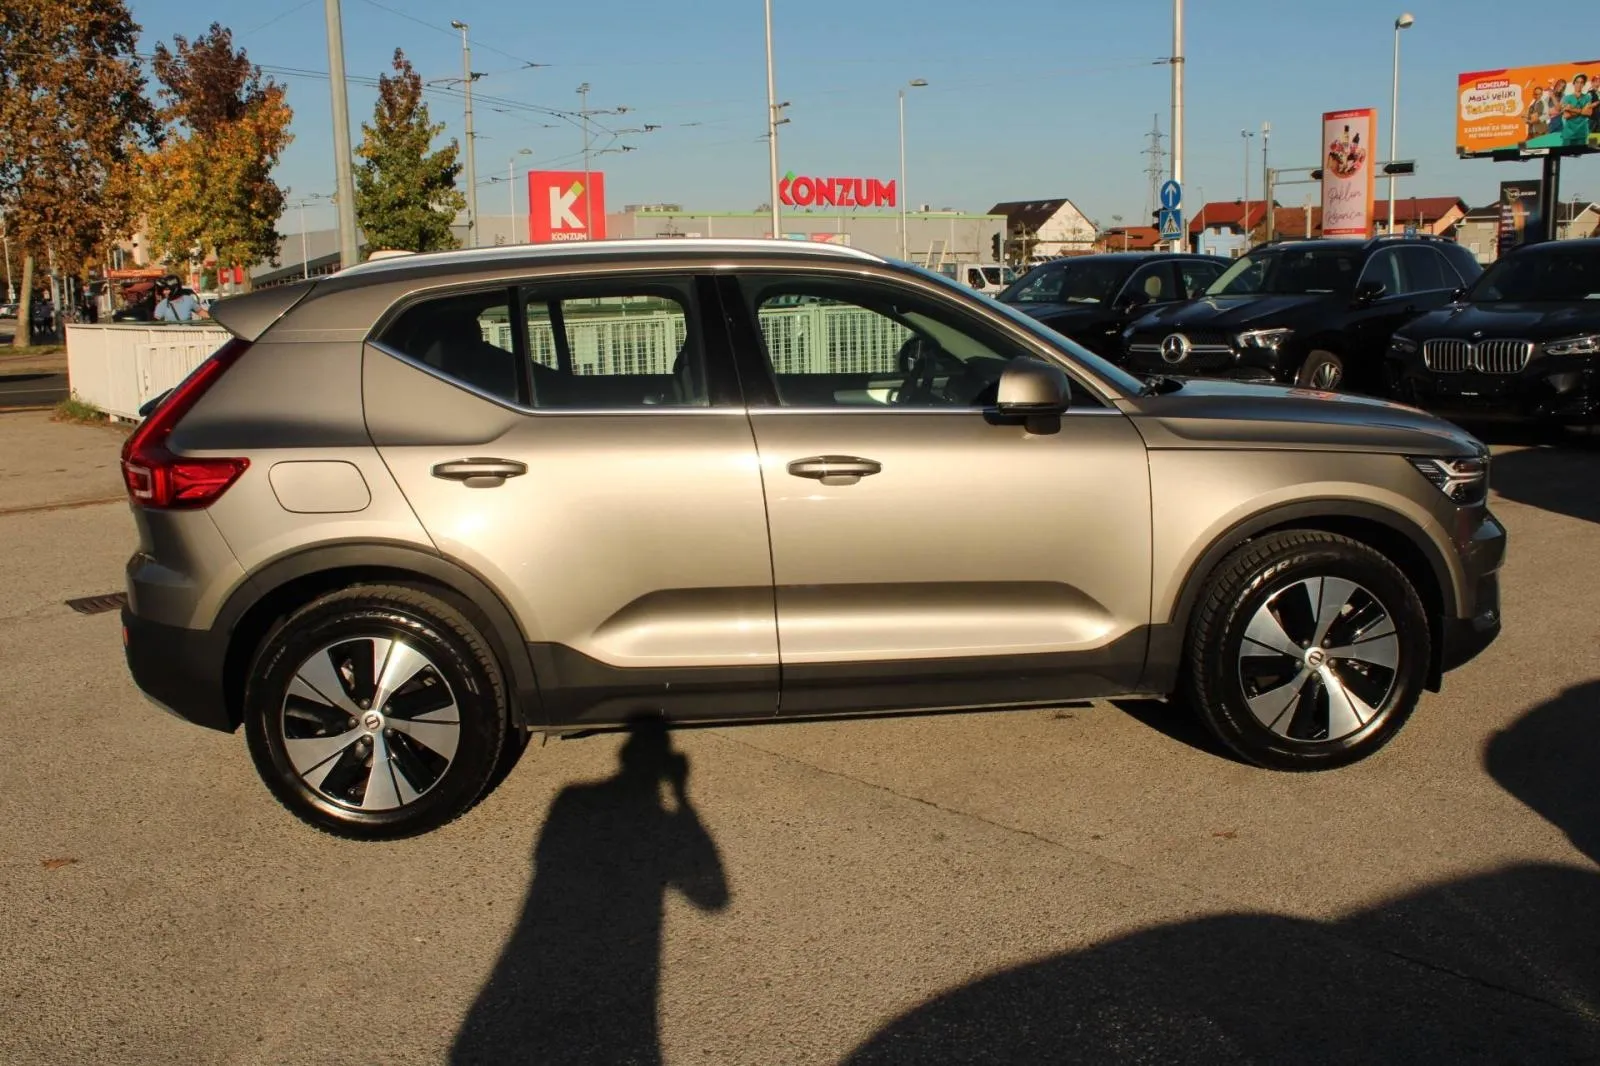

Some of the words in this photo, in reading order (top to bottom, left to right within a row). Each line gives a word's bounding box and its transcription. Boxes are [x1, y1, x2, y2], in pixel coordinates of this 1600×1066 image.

[1477, 81, 1508, 89] KONZUM
[778, 171, 896, 207] KONZUM
[549, 180, 586, 228] K
[551, 232, 587, 240] KONZUM
